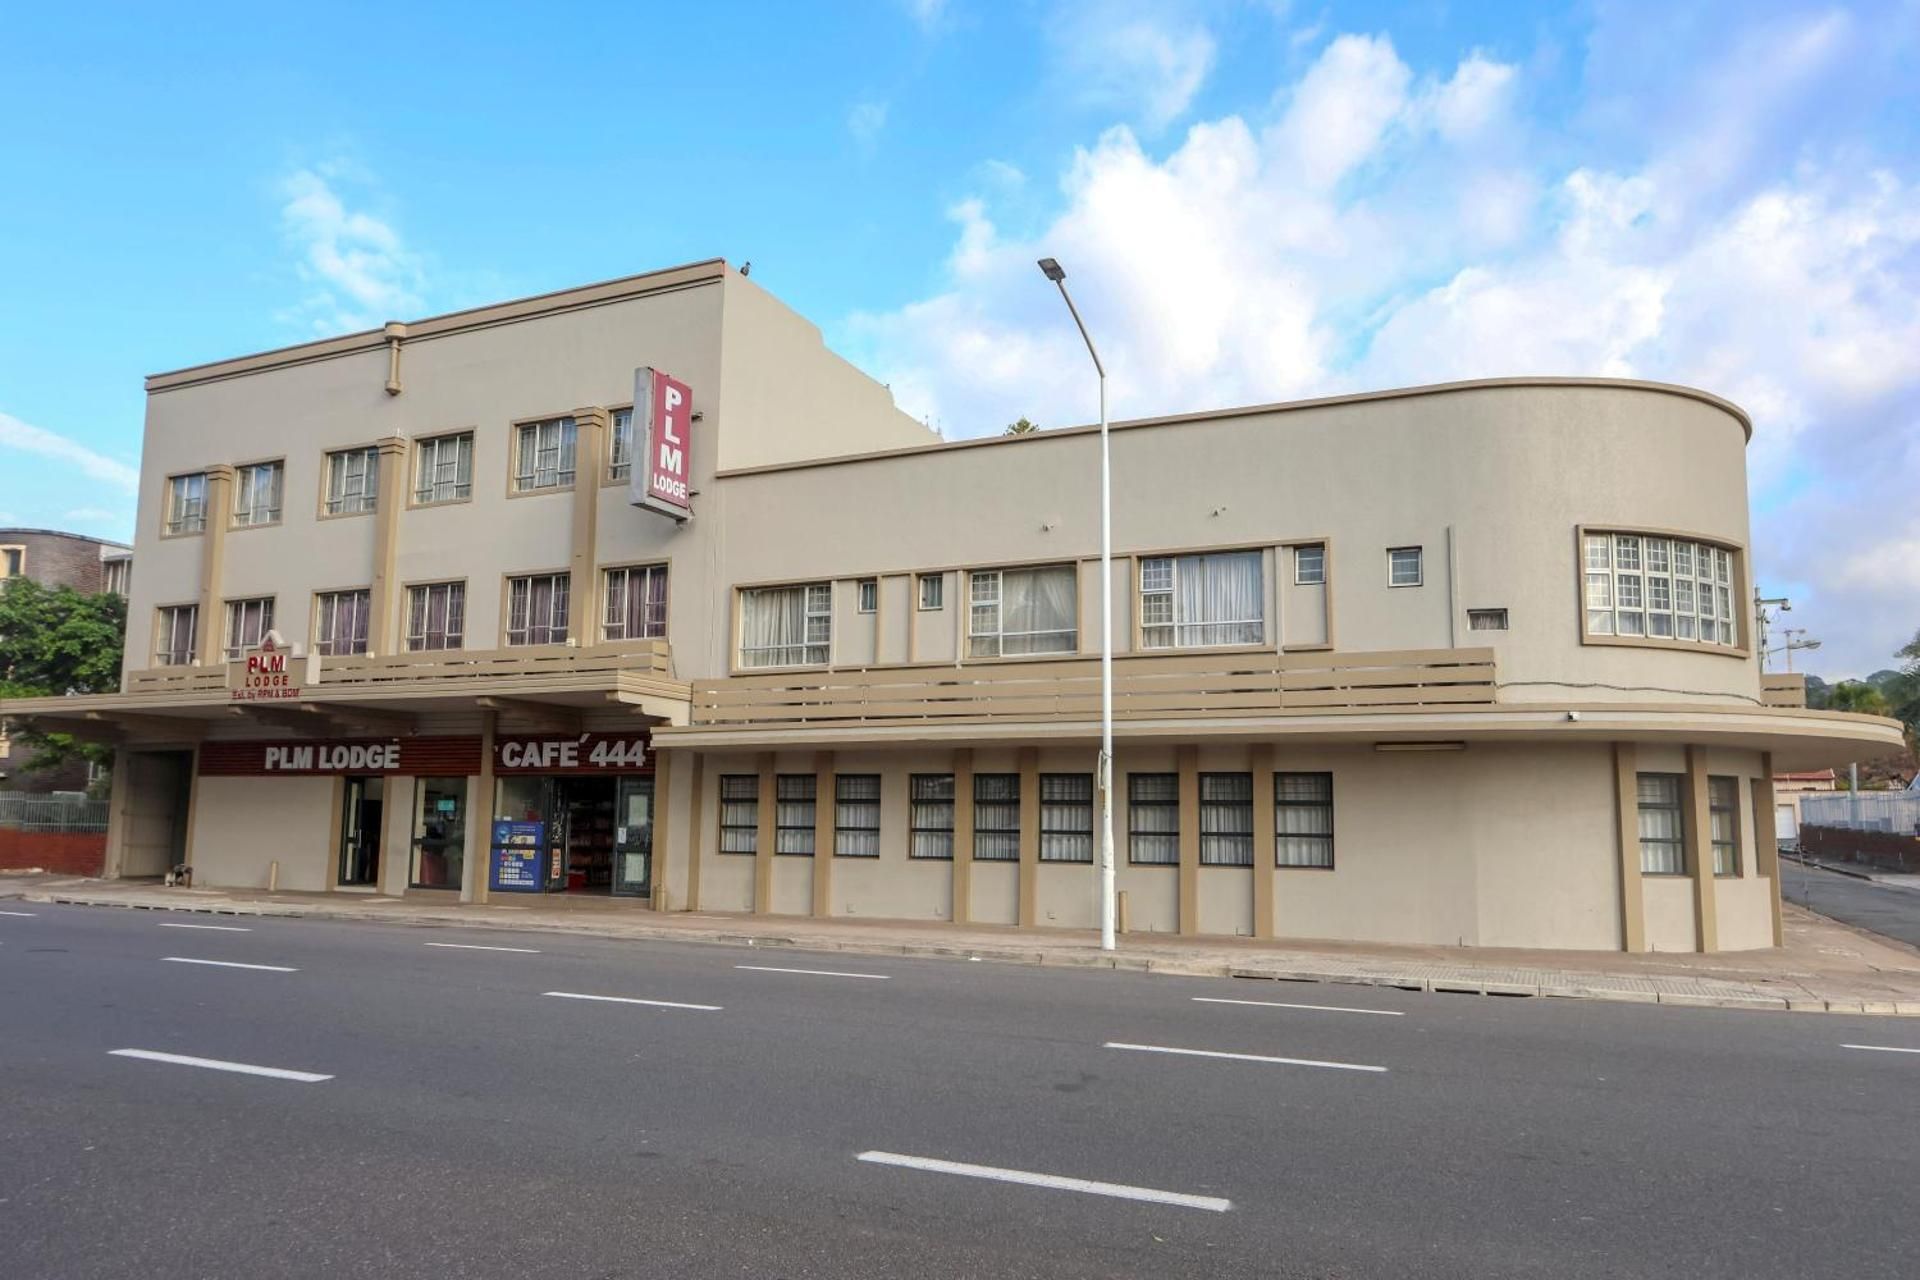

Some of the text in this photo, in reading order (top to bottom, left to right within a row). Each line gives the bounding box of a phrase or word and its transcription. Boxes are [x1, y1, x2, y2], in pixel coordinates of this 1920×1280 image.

[660, 386, 682, 475] PLM
[653, 474, 686, 498] LODGE
[247, 655, 287, 674] PLM
[245, 675, 289, 688] LODGE
[274, 689, 280, 699] &
[264, 745, 400, 769] PLM LODGE
[589, 740, 646, 767] 444
